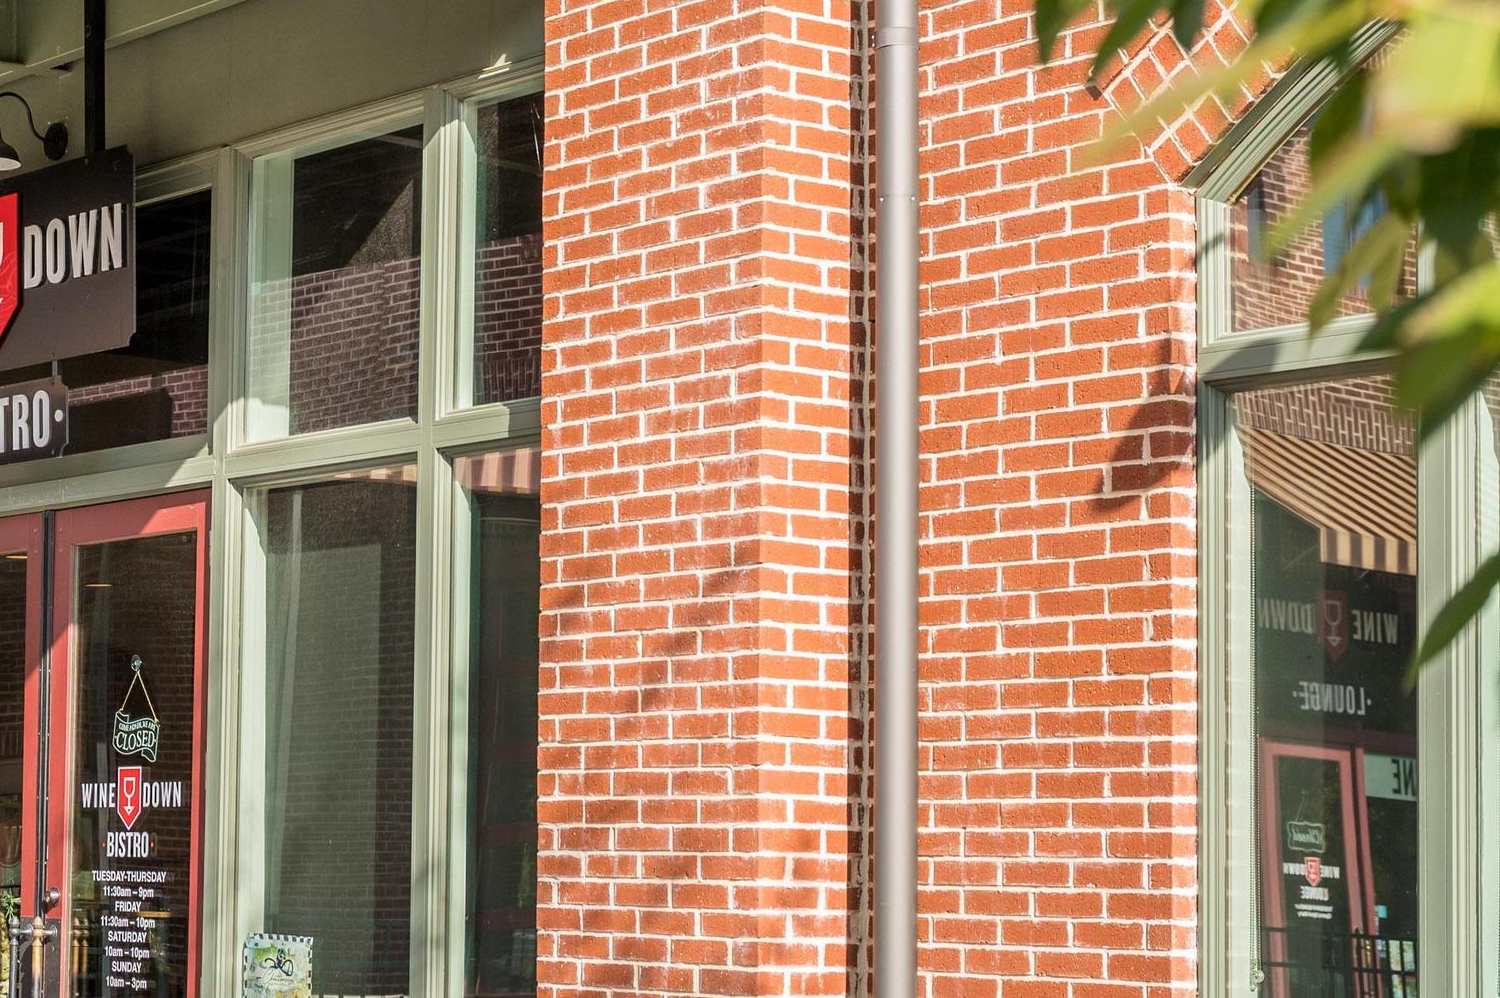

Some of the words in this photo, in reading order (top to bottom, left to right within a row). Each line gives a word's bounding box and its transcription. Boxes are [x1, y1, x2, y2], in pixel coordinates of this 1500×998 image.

[23, 203, 123, 290] DOWN
[116, 730, 156, 750] CLOSED
[81, 782, 116, 808] WINE
[142, 781, 182, 808] DOWN
[106, 832, 149, 858] BISTRO
[102, 886, 132, 897] 11:30am
[138, 887, 154, 900] 9pm
[114, 901, 141, 913] FRIDAY
[100, 916, 129, 928] 11:30am
[136, 917, 156, 930] 10pm
[108, 931, 147, 943] SATURDAY
[104, 946, 123, 957] 10am
[130, 947, 150, 960] 10pm
[111, 961, 142, 973] SUNDAY
[106, 976, 125, 987] 10am
[131, 977, 148, 991] 3pm
